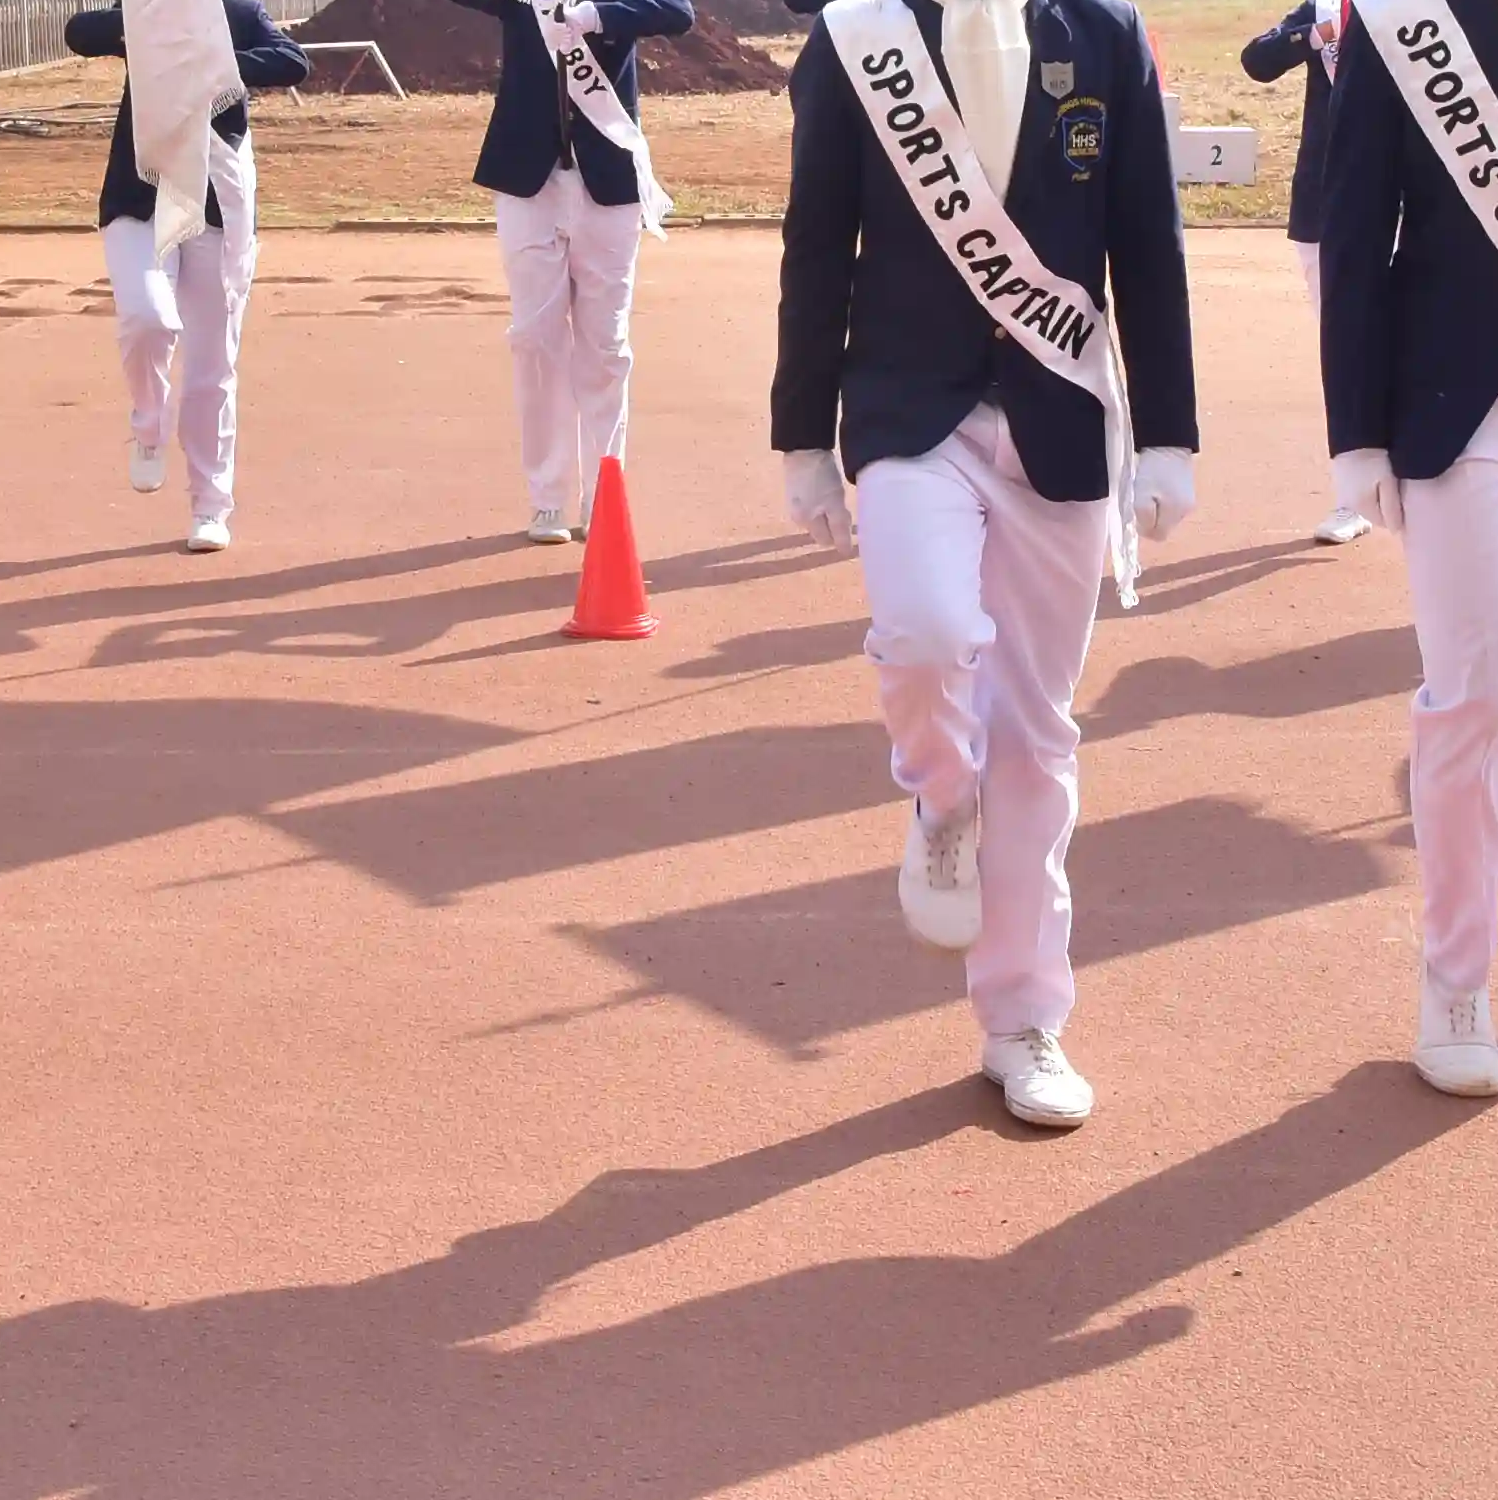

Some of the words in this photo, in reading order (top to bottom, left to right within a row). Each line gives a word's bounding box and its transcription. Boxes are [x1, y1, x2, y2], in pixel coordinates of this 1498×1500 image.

[566, 47, 608, 95] BOY
[1072, 134, 1097, 148] HHS
[1210, 144, 1222, 166] 2
[862, 48, 971, 221] SPORTS
[956, 229, 1096, 361] CAPTAIN
